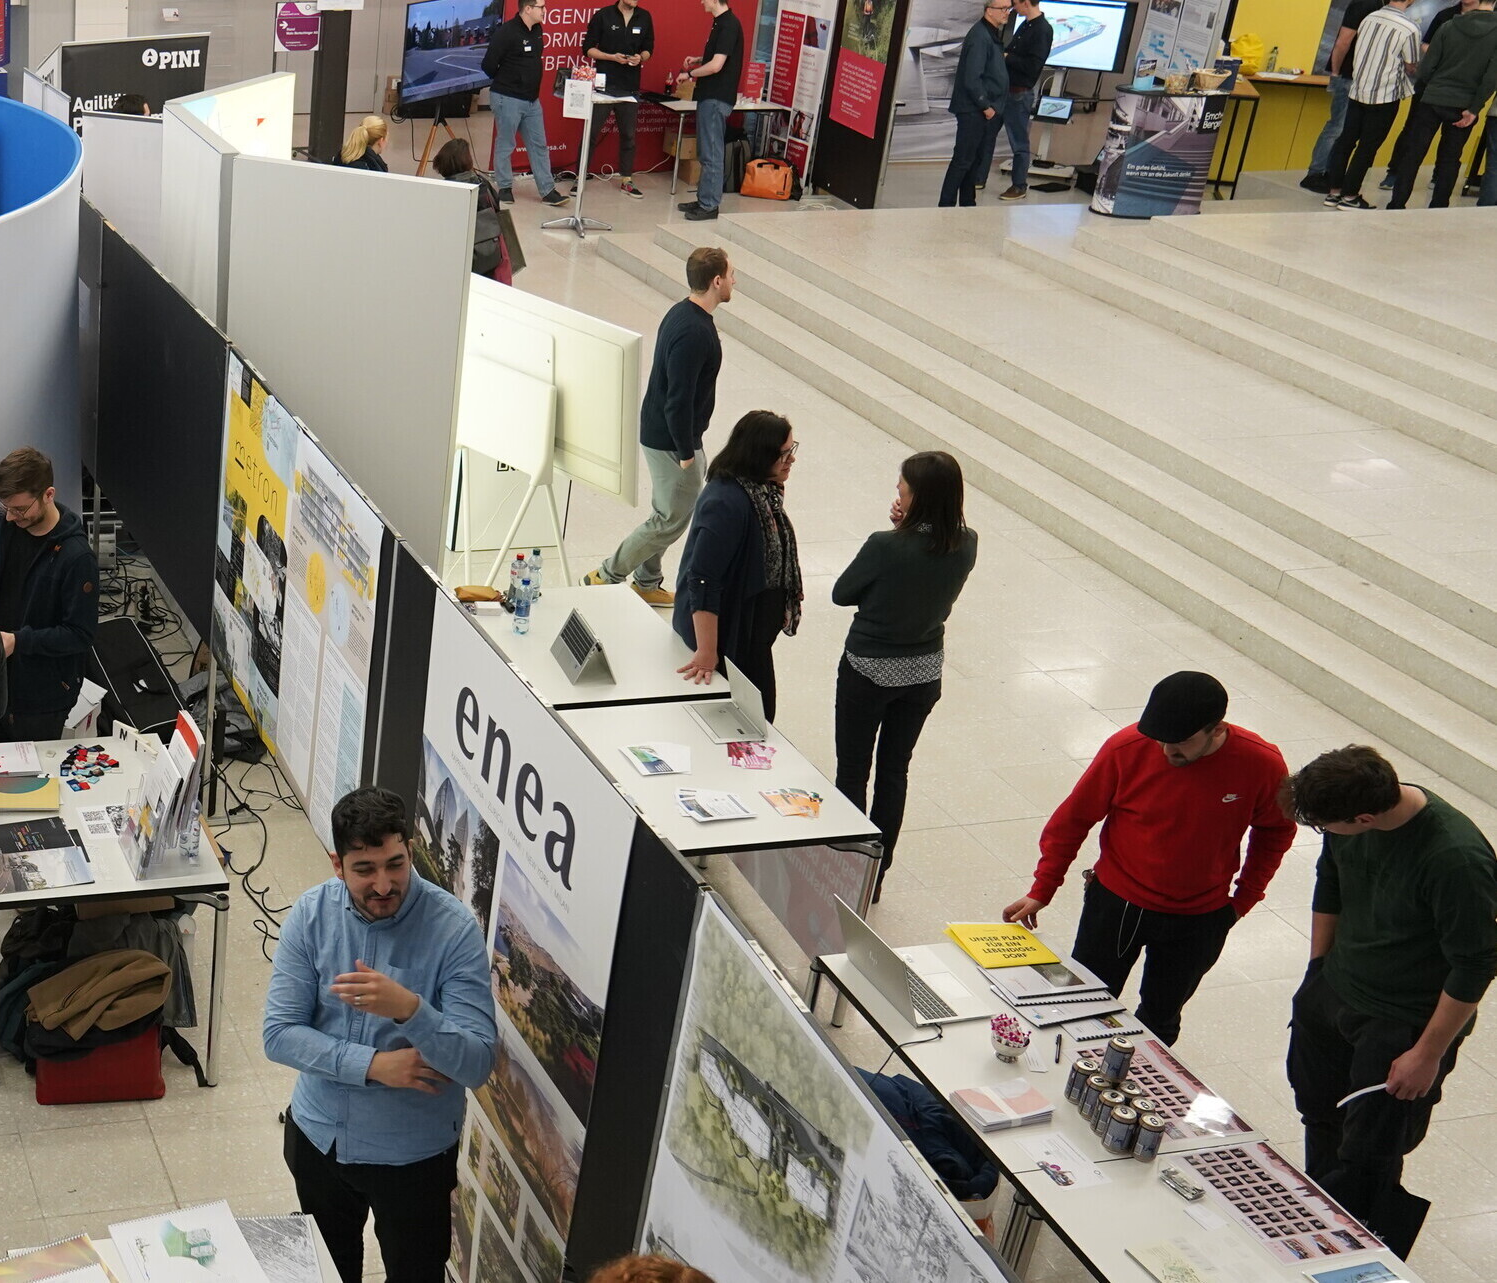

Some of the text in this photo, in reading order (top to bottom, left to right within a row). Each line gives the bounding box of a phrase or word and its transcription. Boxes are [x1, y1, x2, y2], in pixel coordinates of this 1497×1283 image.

[543, 32, 587, 48] ORME
[158, 49, 201, 70] PINI
[234, 440, 278, 517] metron
[456, 686, 576, 892] enea
[982, 946, 1037, 954] LEBENDIGES
